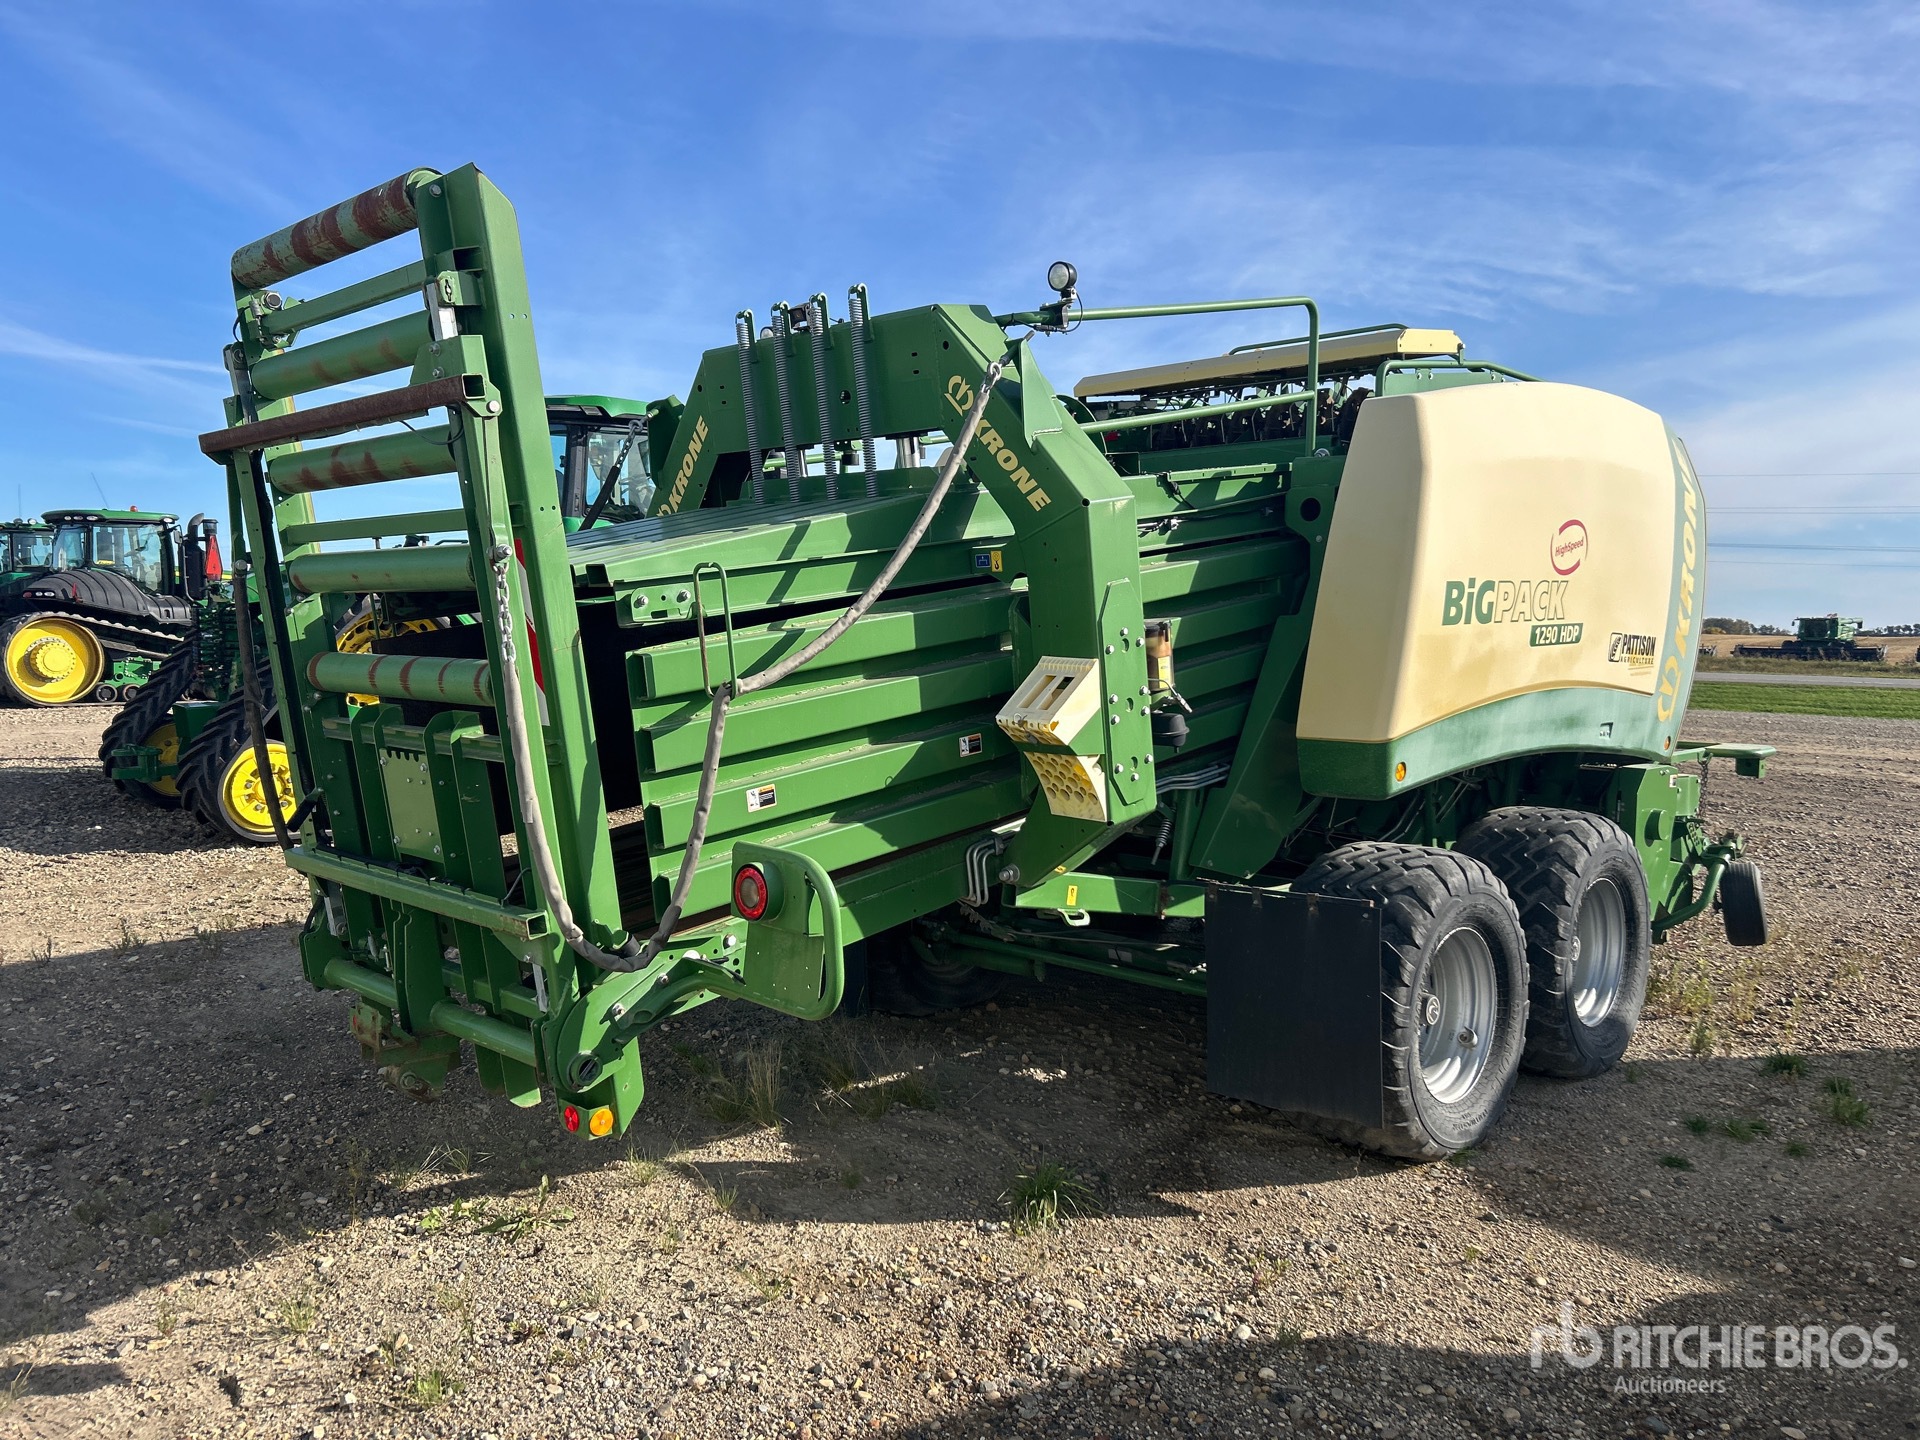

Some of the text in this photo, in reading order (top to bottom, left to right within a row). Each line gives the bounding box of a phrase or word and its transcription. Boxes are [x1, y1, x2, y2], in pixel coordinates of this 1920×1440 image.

[668, 415, 709, 513] KRONE
[1535, 625, 1580, 645] 1290 HDP
[1621, 633, 1657, 657] PATTISON
